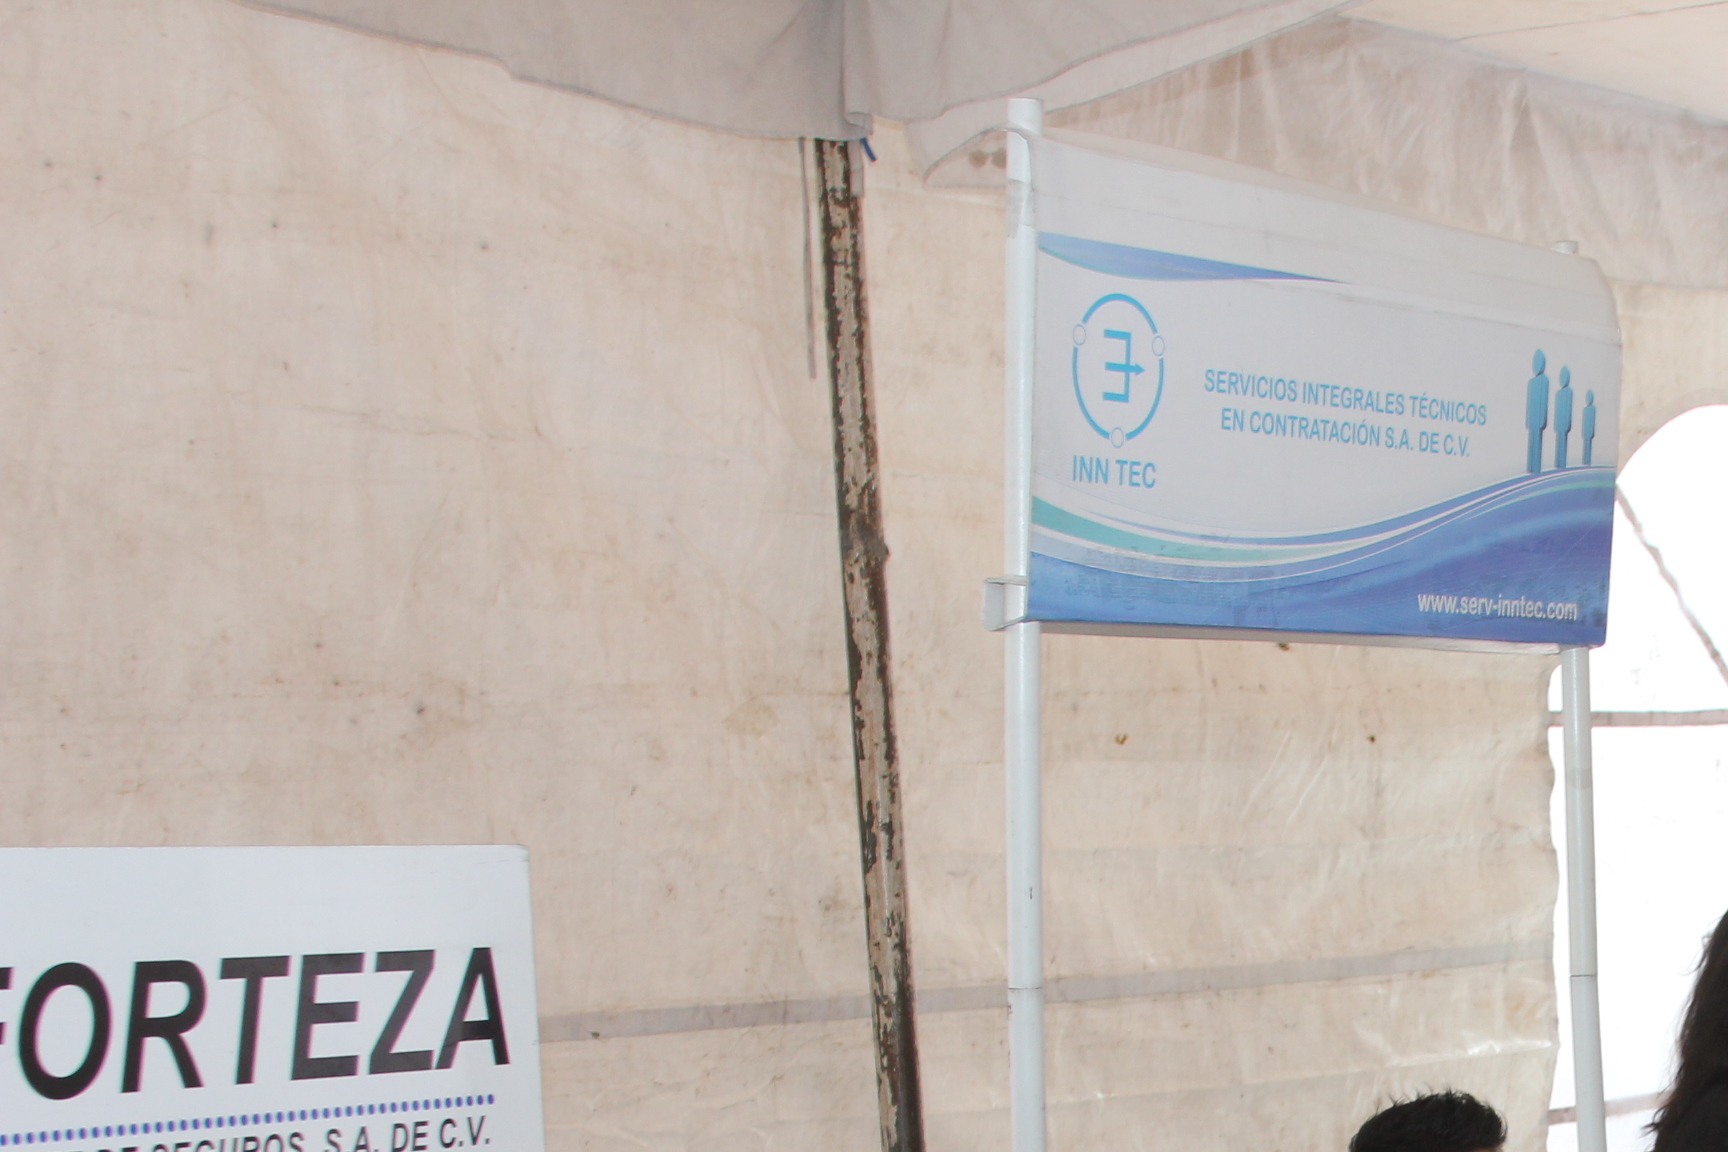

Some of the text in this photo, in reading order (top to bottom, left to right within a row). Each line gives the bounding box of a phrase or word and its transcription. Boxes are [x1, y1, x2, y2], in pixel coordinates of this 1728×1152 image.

[1204, 369, 1487, 426] SERVICIOS INTEGRALES TÉCNICOS
[1221, 407, 1469, 457] EN CONTRATACIÓN S.A. DE C.V.
[1072, 455, 1156, 489] INN TEC
[1417, 593, 1578, 621] www.serv-inntec.com
[0, 947, 510, 1100] ORTEZA
[439, 1114, 491, 1149] C.V.
